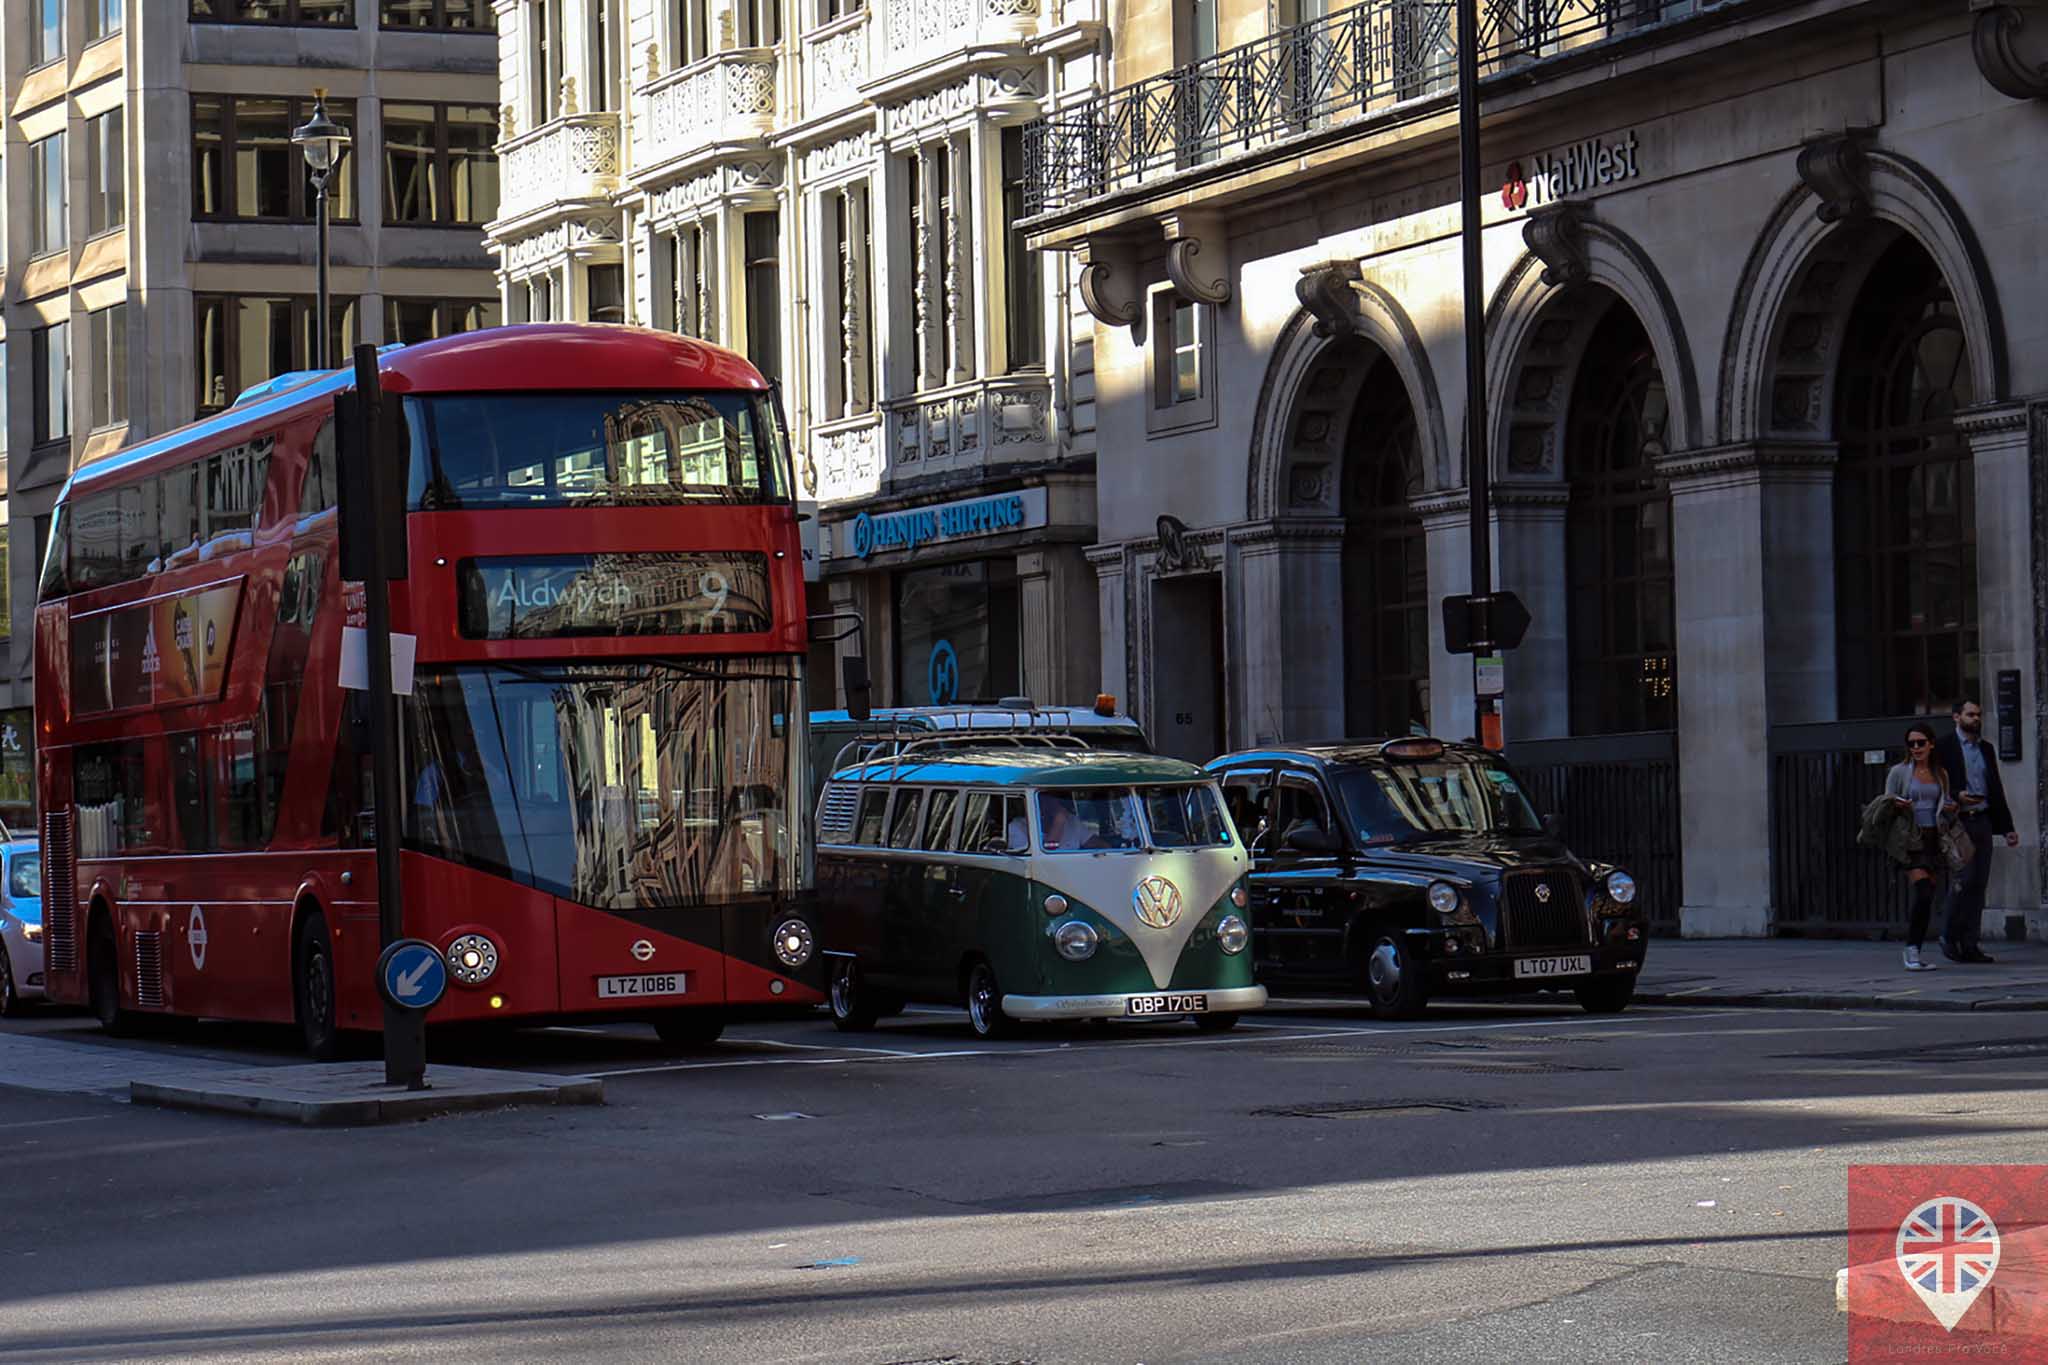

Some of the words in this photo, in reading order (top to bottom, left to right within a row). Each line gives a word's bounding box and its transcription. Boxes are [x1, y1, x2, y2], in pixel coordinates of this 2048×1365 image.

[1532, 130, 1639, 204] NatWest
[874, 510, 936, 549] HANJIN
[940, 495, 1023, 537] SHIPPING
[497, 578, 633, 614] Aldwych
[699, 570, 729, 617] 9
[1520, 959, 1556, 974] LT07
[1560, 957, 1586, 972] UXL
[607, 978, 638, 995] LTZ
[642, 976, 676, 993] 1086
[1131, 996, 1165, 1013] OBP
[1167, 995, 1205, 1012] 170E
